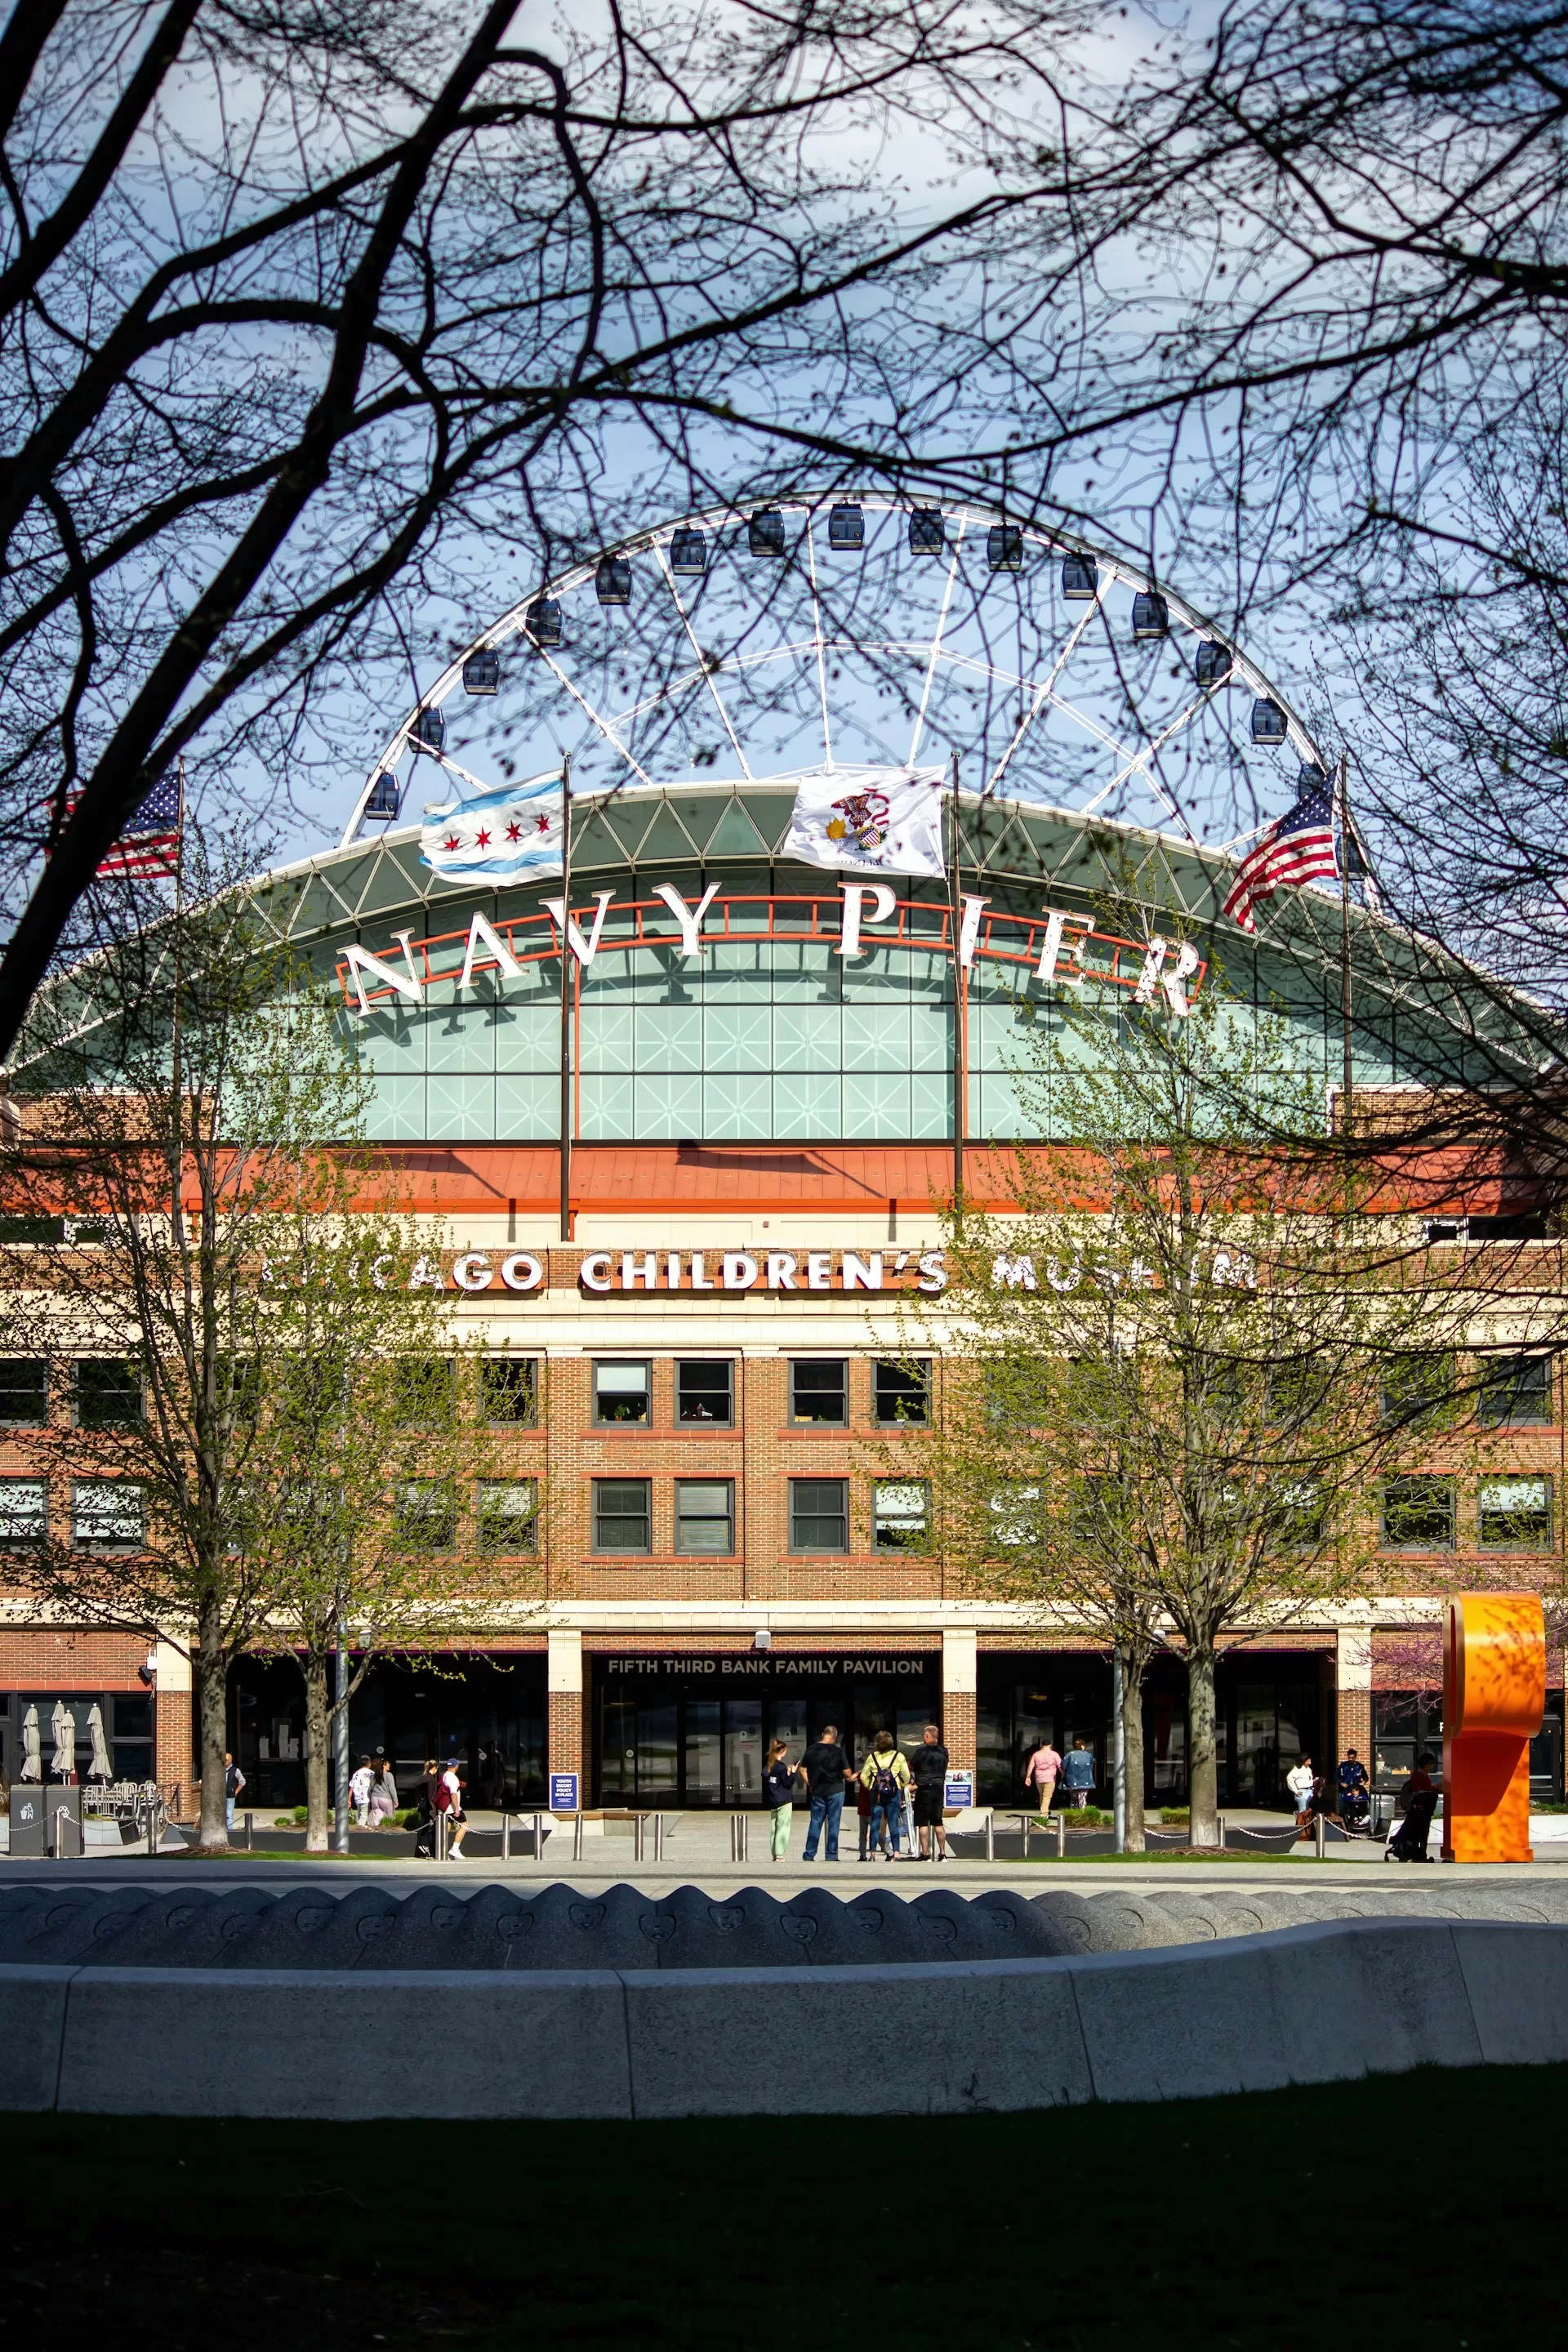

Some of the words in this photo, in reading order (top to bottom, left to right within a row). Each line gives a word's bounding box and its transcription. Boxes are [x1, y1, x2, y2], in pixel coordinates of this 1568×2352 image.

[336, 881, 722, 1018] NAVY
[837, 882, 1200, 1018] PIER
[581, 1250, 949, 1291] CHILDREN'S
[608, 1659, 658, 1674] FIFTH
[663, 1659, 716, 1674] THIRD
[722, 1659, 771, 1674] BANK
[775, 1659, 839, 1674] FAMILY
[843, 1659, 924, 1674] PAVILION
